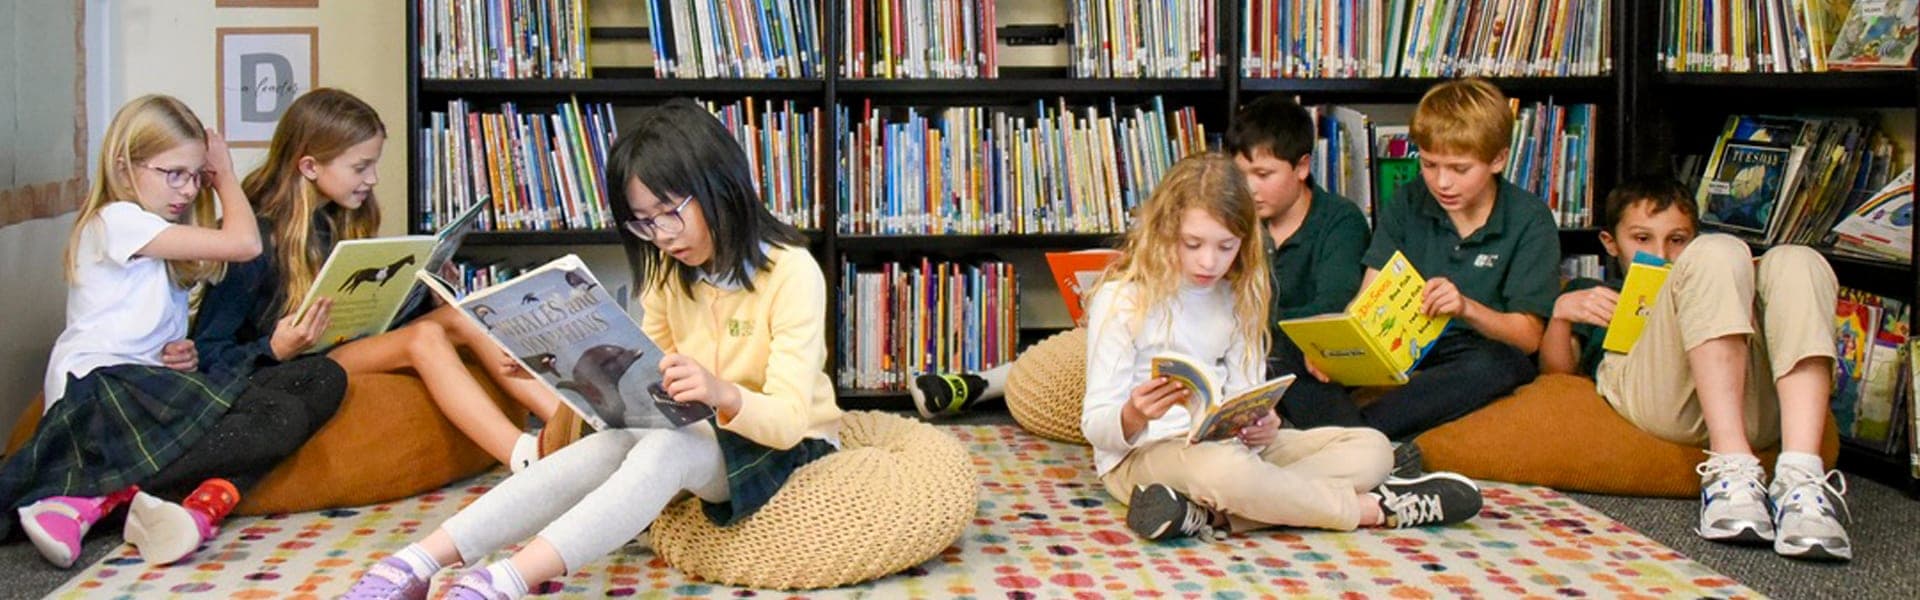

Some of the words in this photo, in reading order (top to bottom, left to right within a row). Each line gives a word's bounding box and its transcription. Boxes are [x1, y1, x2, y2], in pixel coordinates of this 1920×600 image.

[240, 53, 294, 122] D
[1732, 150, 1778, 166] TUESDAY
[495, 298, 567, 337] WHALES
[567, 290, 598, 314] and
